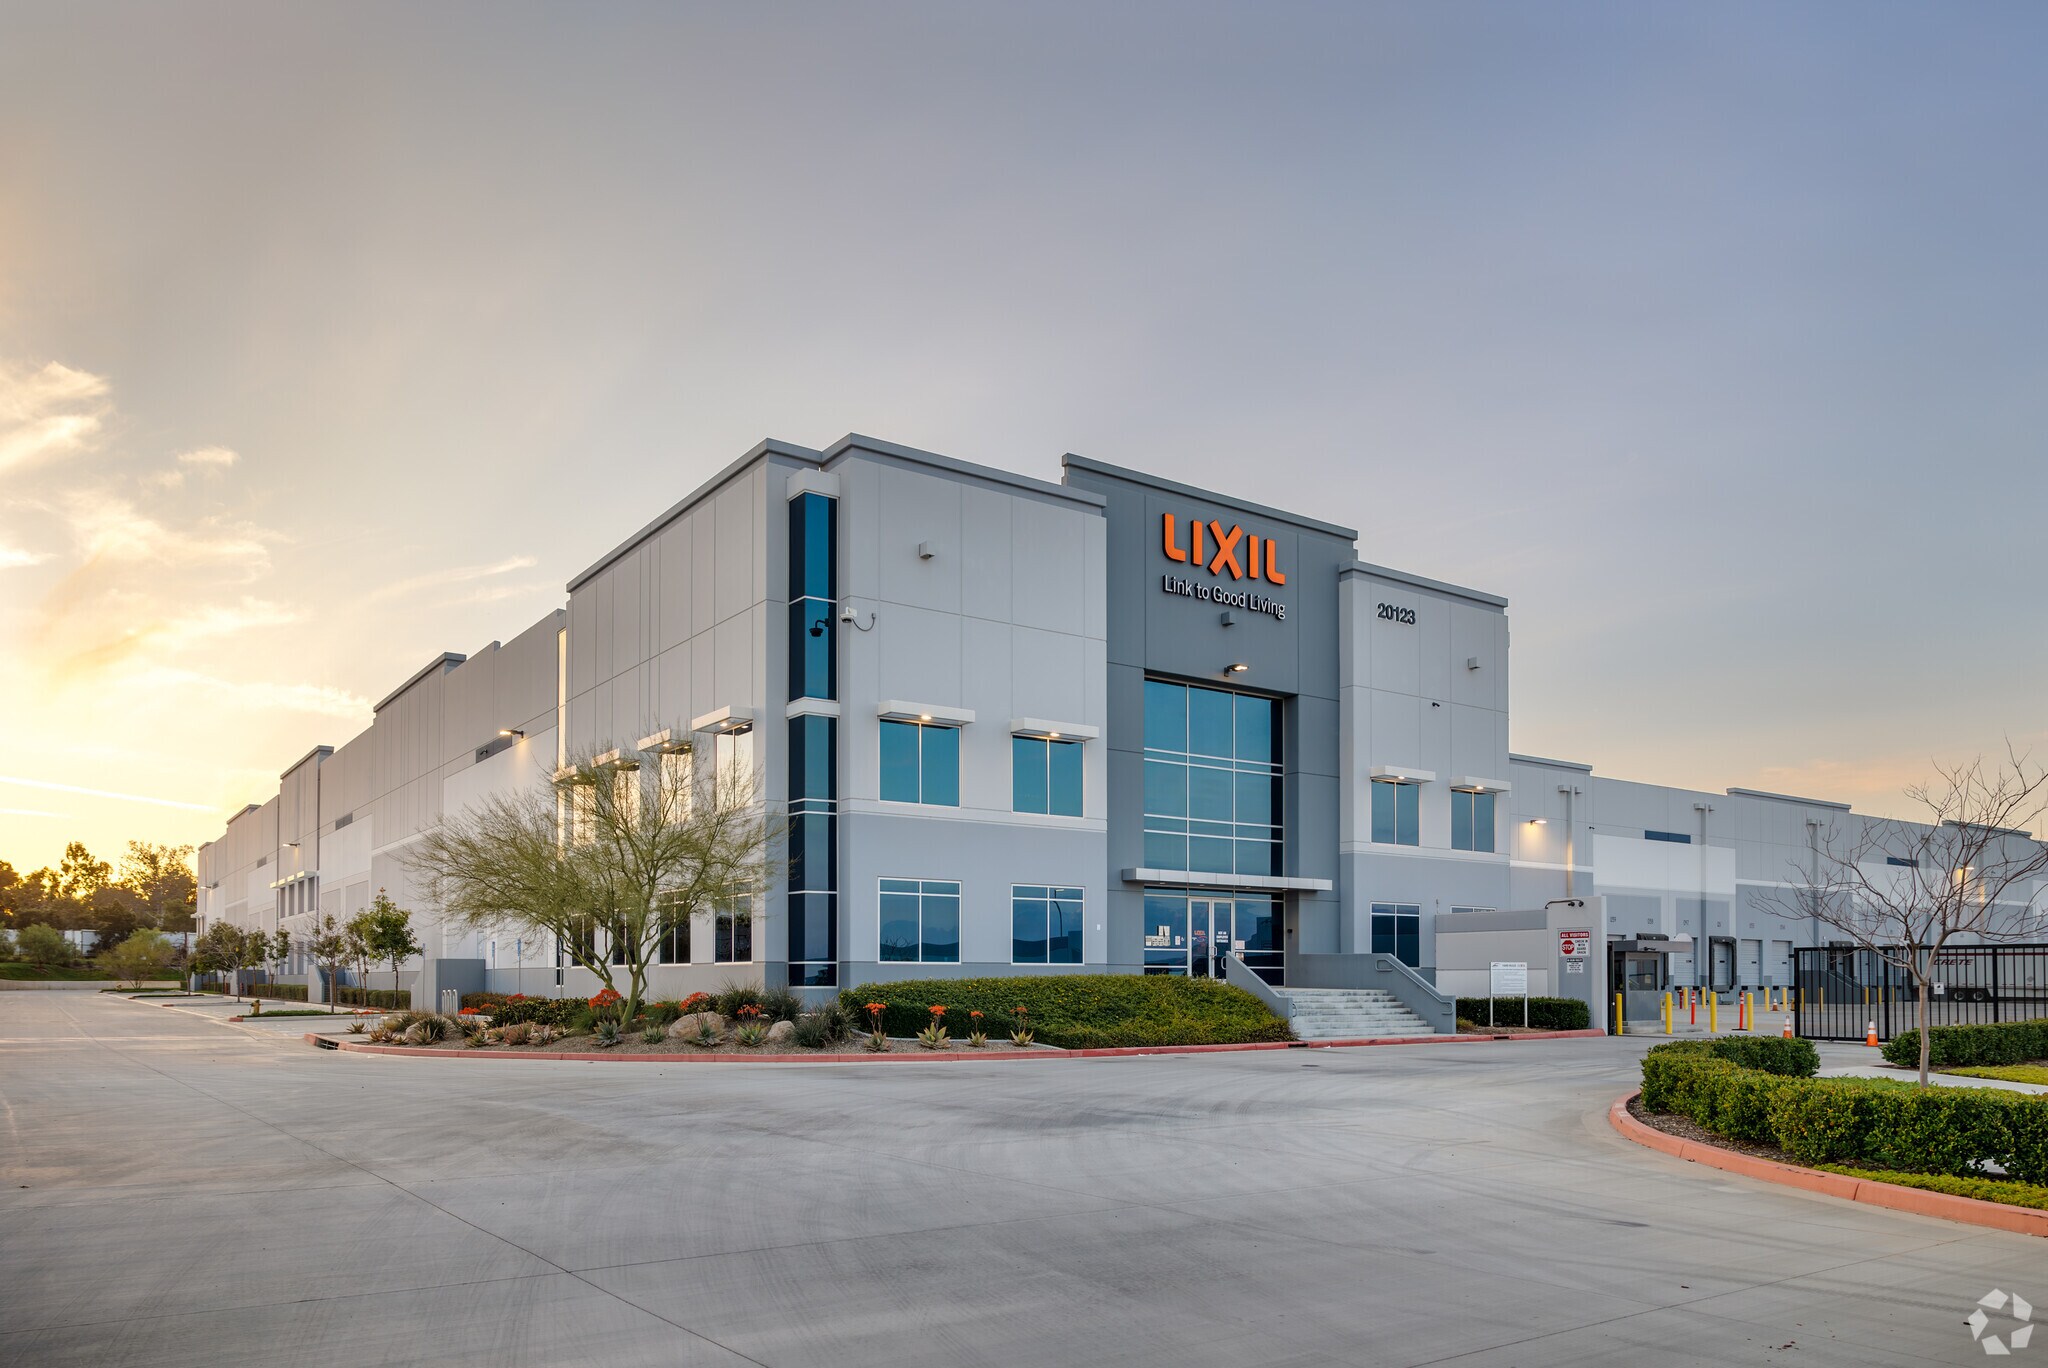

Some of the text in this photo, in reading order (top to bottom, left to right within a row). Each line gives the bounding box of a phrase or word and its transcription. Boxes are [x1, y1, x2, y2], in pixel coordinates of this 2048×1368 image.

[1162, 512, 1286, 585] LIXIL
[1163, 575, 1286, 620] Link to Good Living
[1377, 602, 1416, 625] 20123
